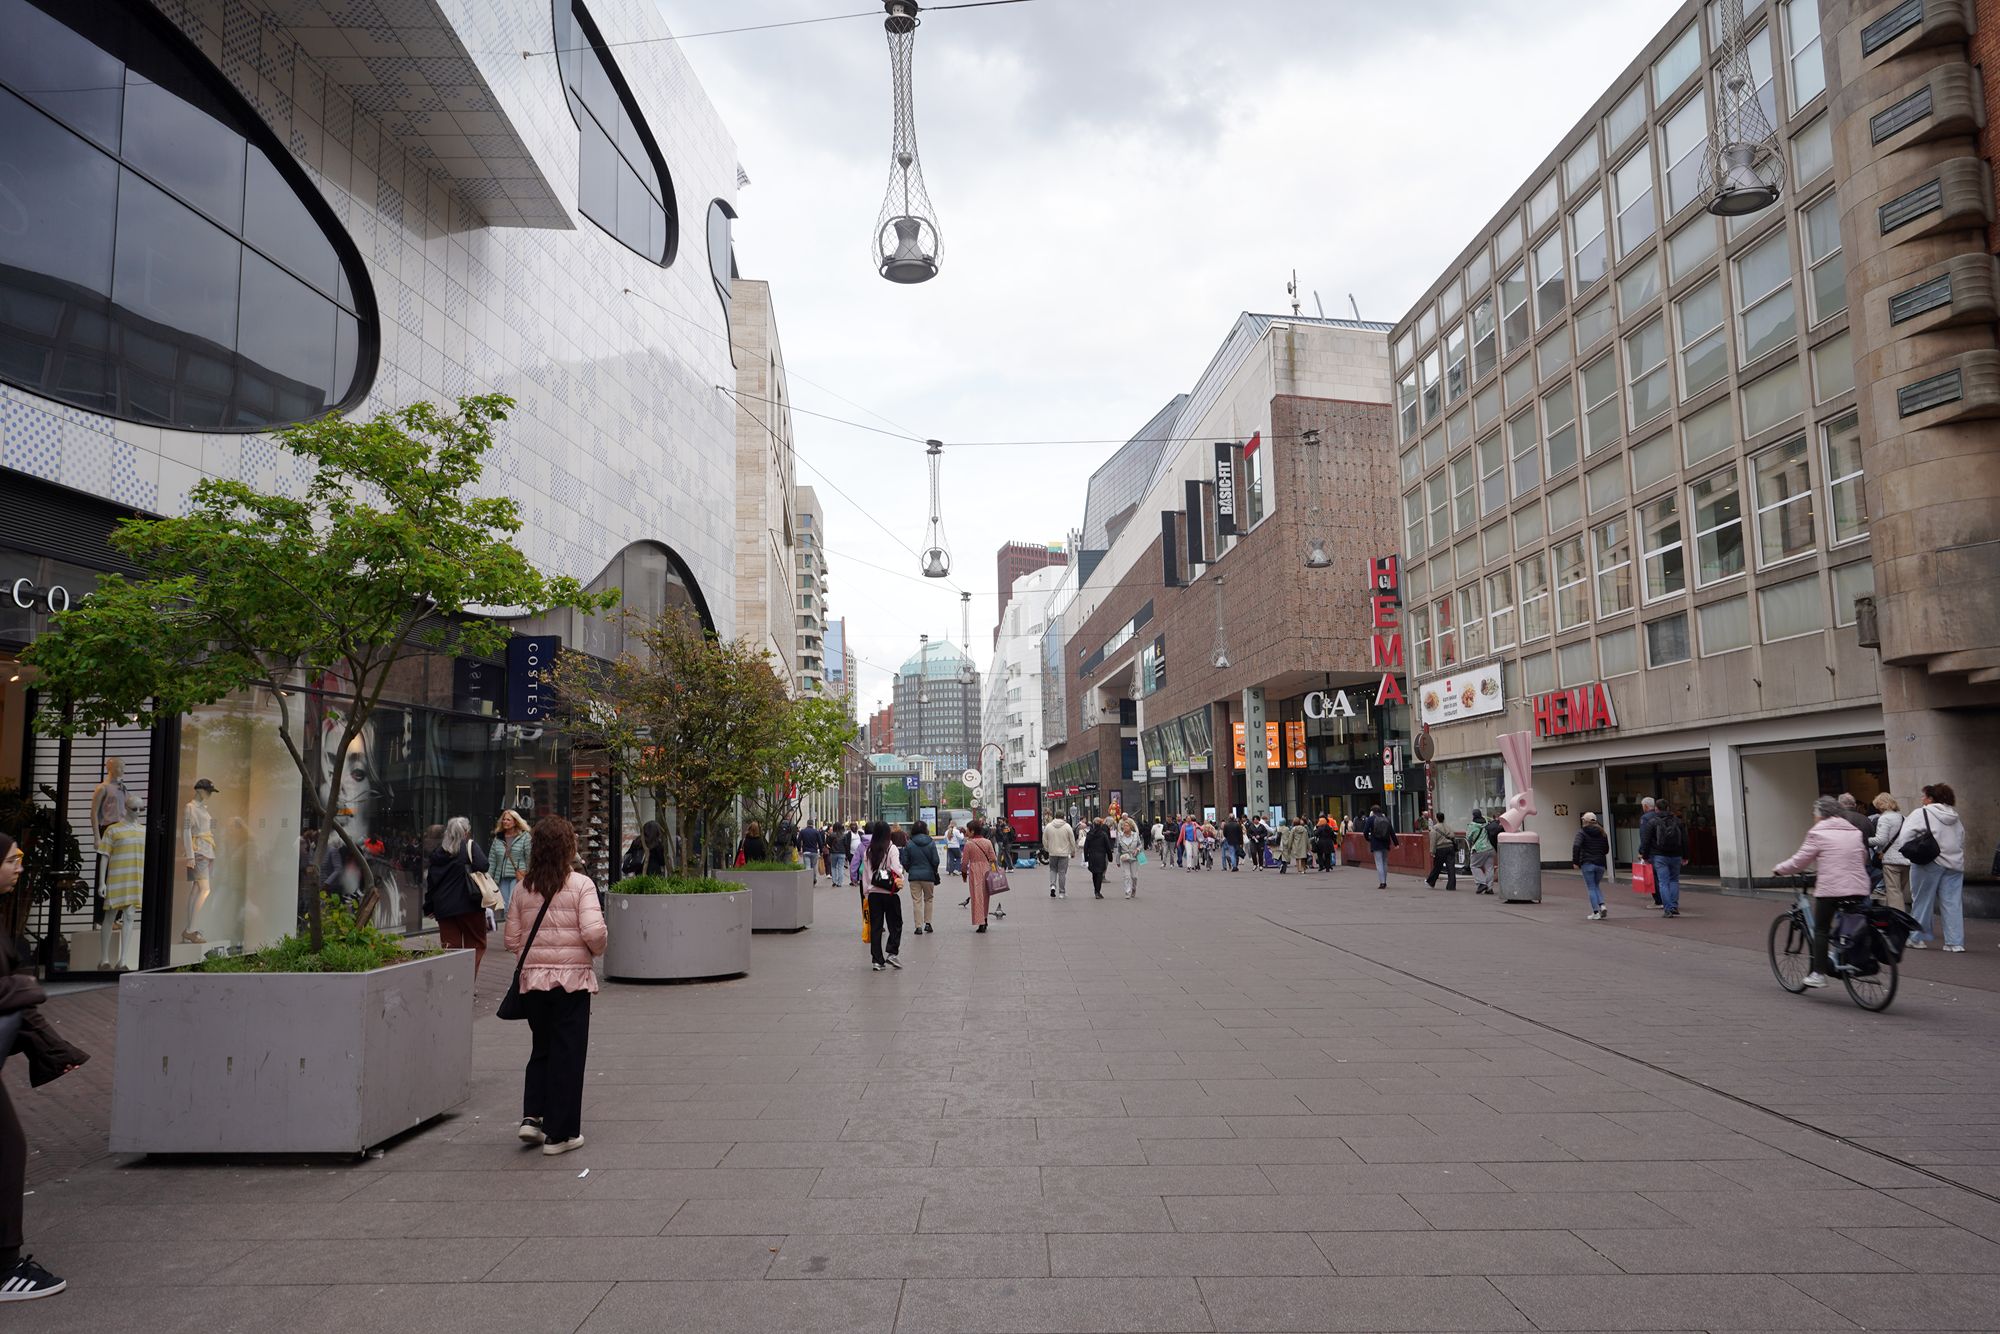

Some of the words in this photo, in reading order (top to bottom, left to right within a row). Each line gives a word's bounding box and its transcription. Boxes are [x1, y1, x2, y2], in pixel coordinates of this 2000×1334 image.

[1218, 461, 1232, 514] BASIC-FIT
[1368, 557, 1405, 706] HEMA
[527, 643, 539, 715] COSTES
[1303, 689, 1356, 719] C&A
[1533, 683, 1614, 737] HEMA
[1252, 691, 1264, 817] SPUIMARKT
